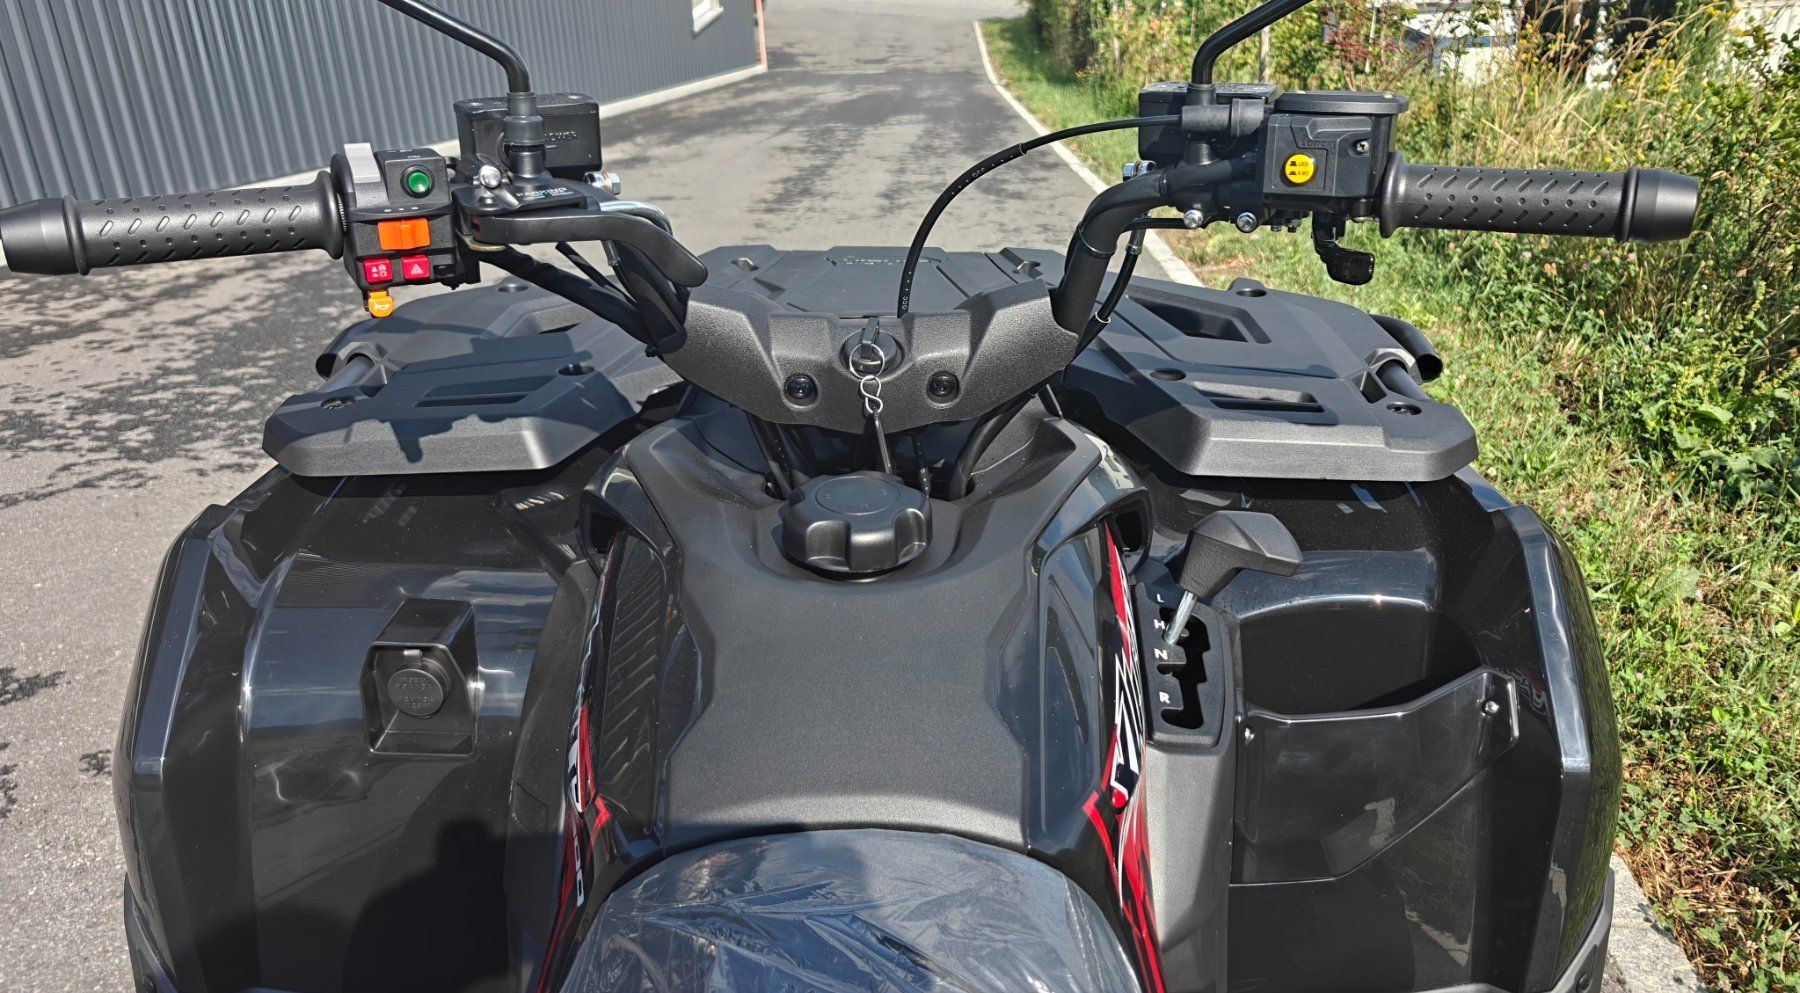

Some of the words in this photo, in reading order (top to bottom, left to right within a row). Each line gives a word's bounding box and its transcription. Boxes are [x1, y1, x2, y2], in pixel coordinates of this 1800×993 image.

[1156, 593, 1164, 603] L
[1154, 619, 1165, 630] H
[1154, 648, 1168, 660] N
[1159, 691, 1171, 704] R
